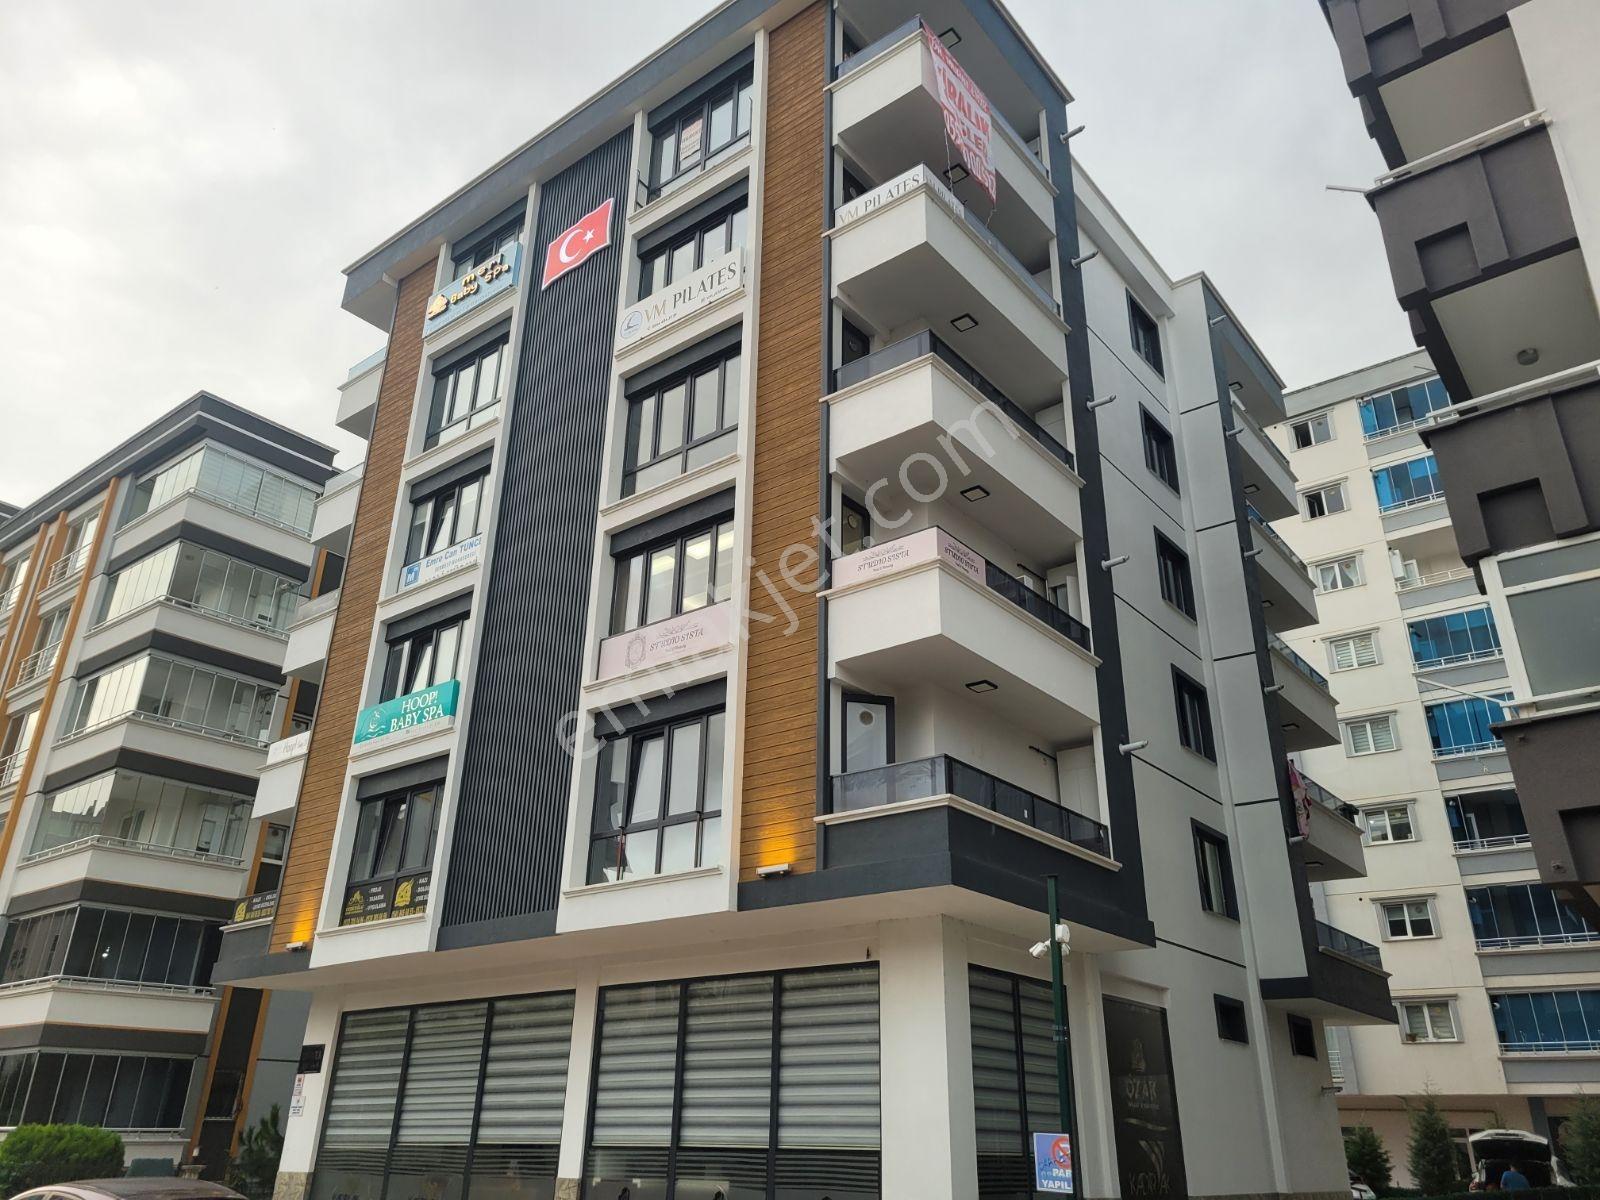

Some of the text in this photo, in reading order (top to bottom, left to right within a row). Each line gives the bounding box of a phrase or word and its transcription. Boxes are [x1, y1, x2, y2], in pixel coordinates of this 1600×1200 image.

[864, 173, 920, 213] PILATES
[645, 299, 667, 322] VM
[673, 261, 737, 309] PILATES
[390, 710, 421, 732] BABY
[422, 704, 444, 723] SPA
[401, 691, 439, 714] HOOP!
